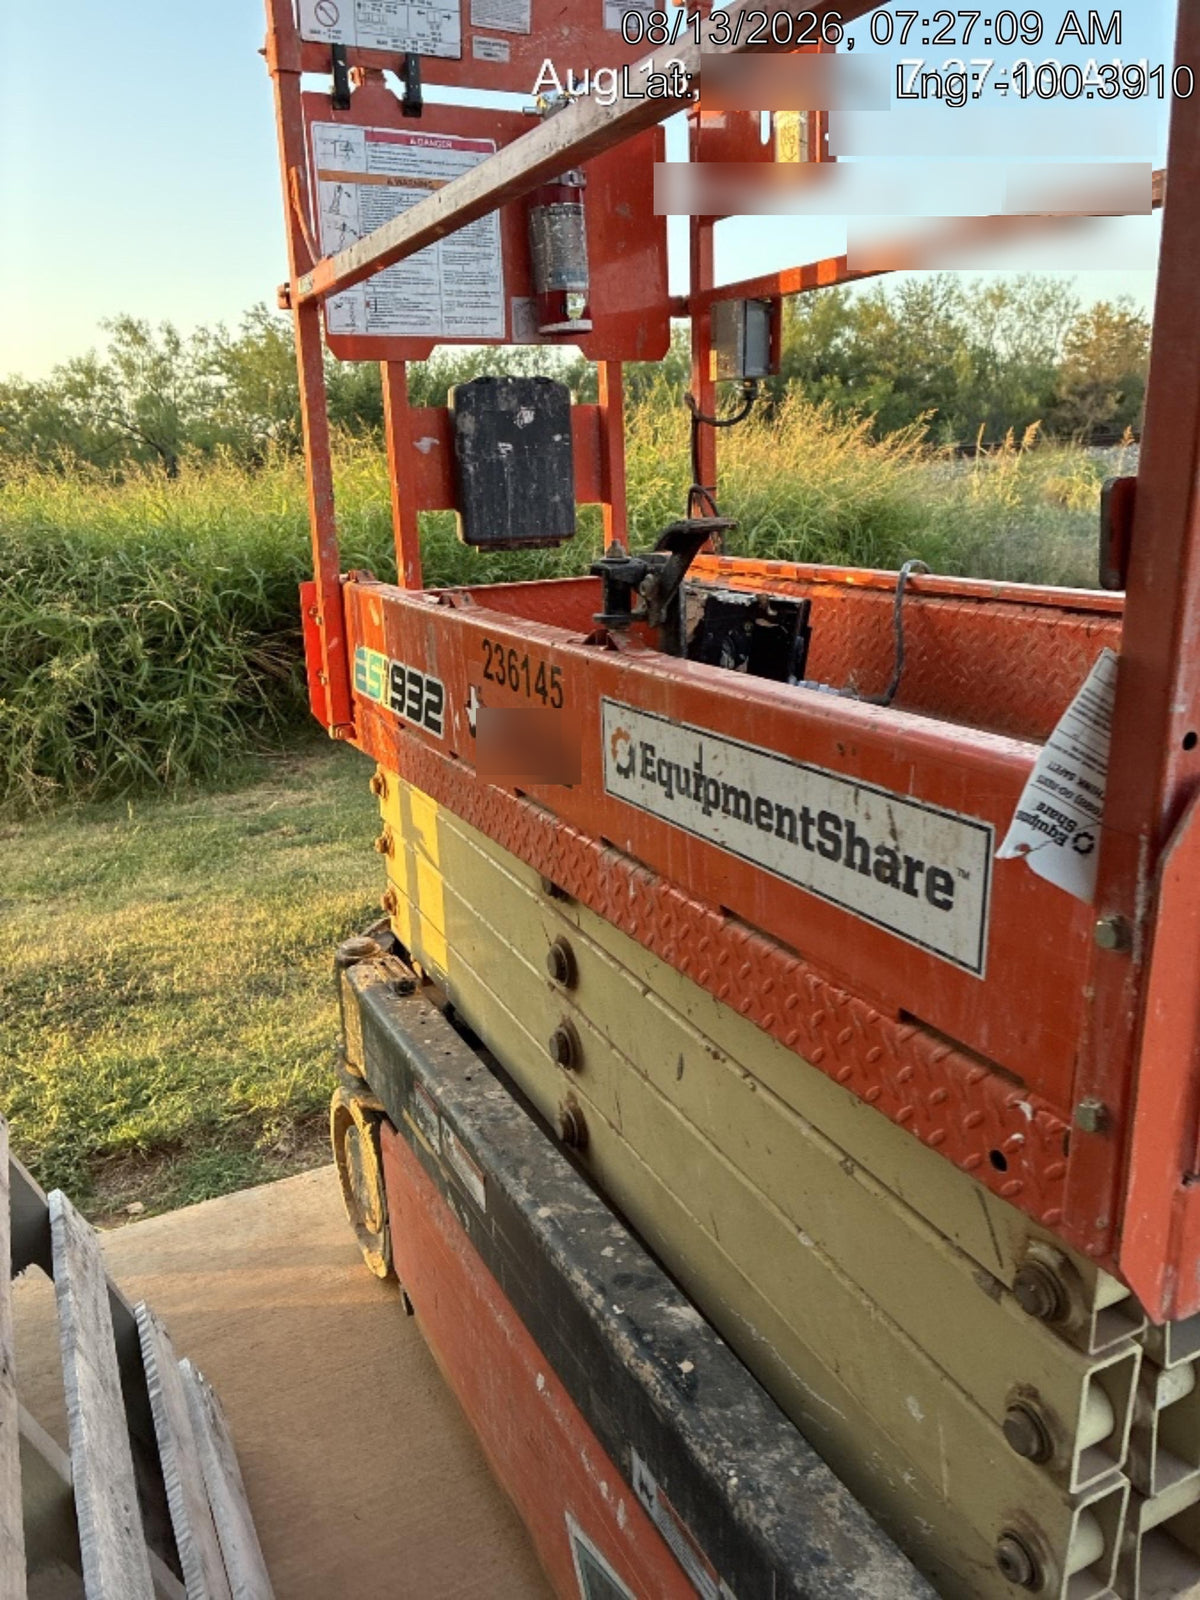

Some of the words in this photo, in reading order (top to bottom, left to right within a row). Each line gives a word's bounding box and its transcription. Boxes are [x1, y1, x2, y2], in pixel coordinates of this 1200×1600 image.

[482, 638, 564, 709] 236145
[640, 741, 955, 912] EquipmentShare
[1036, 802, 1078, 833] Share
